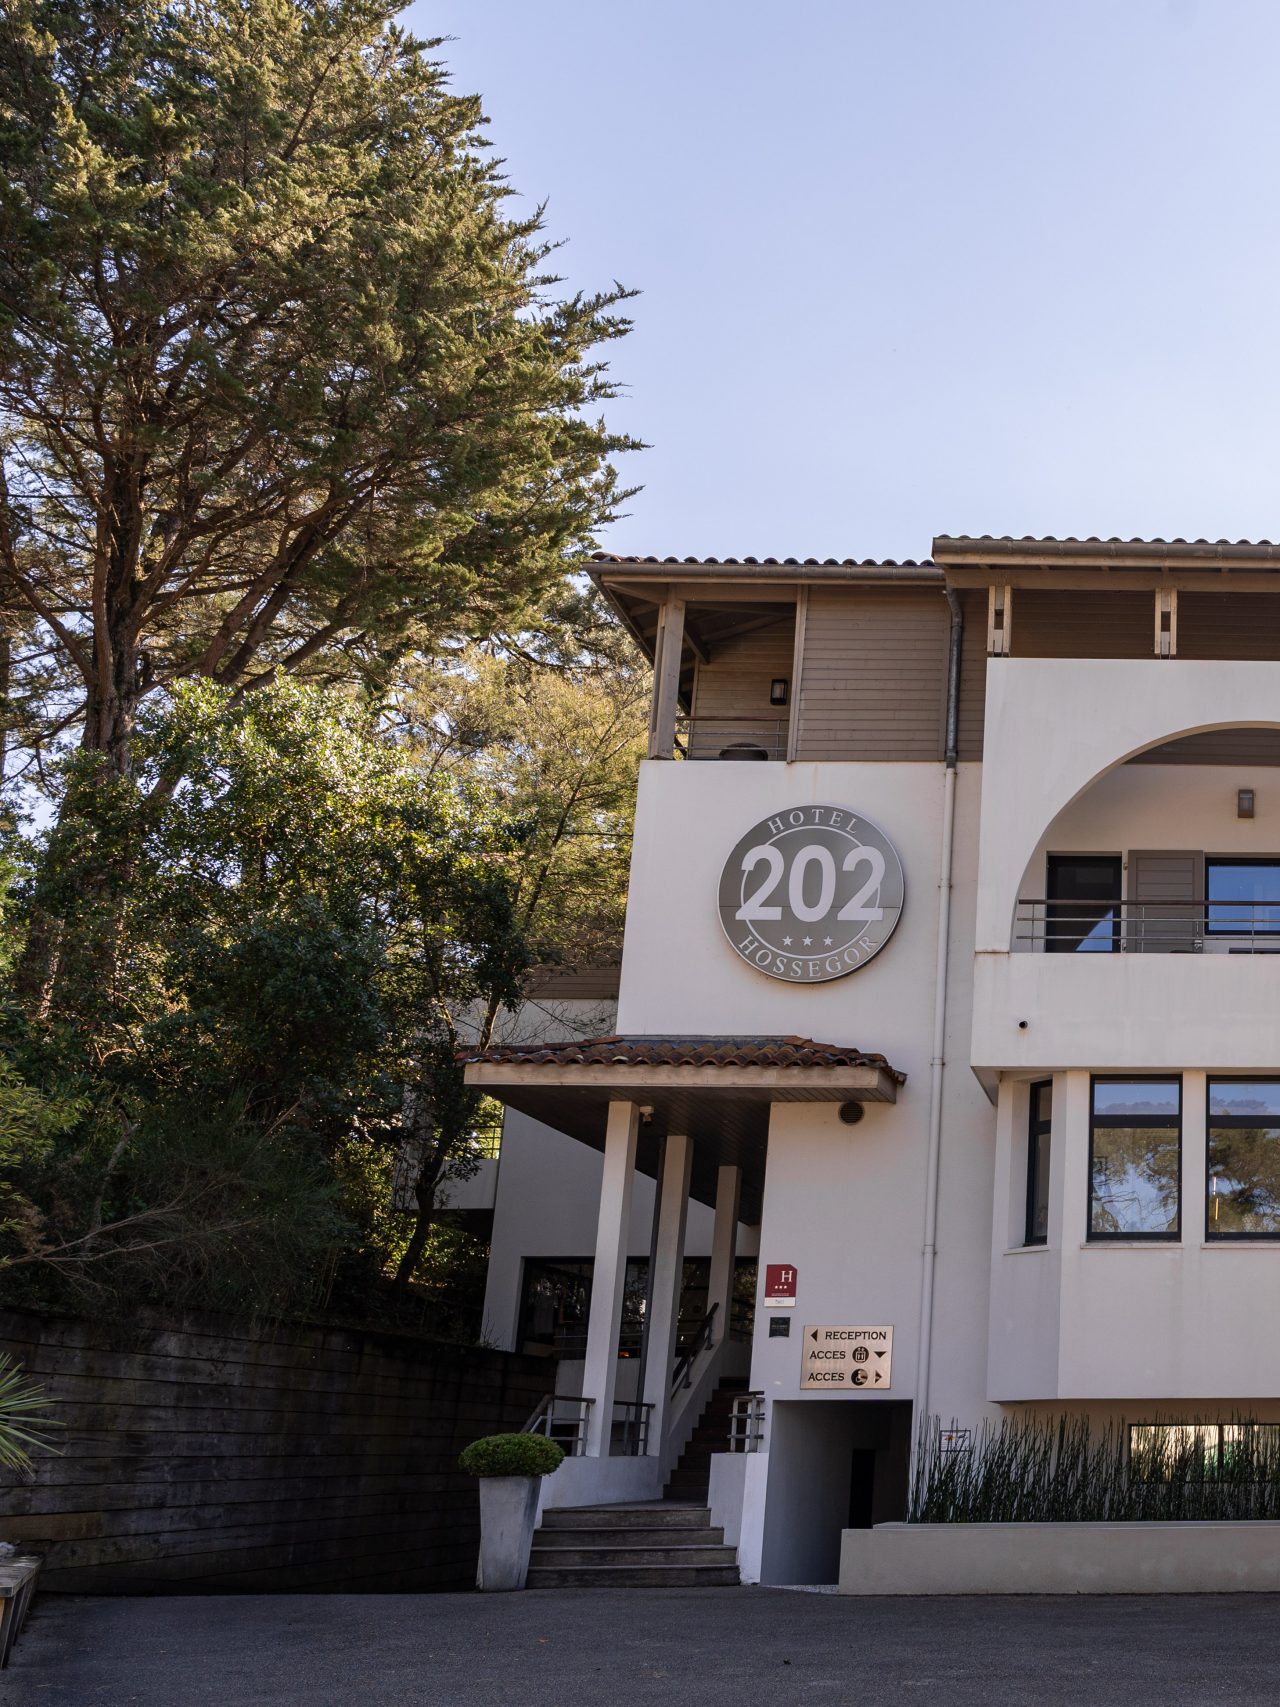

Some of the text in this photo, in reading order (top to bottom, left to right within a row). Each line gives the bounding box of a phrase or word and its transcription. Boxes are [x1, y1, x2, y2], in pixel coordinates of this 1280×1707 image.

[767, 808, 857, 834] HOTEL
[735, 844, 886, 922] 202
[738, 935, 878, 977] HOSSEGOR
[780, 1270, 793, 1283] H
[825, 1331, 887, 1340] RECEPTION
[809, 1350, 846, 1360] ACCES
[807, 1372, 845, 1382] ACCES
